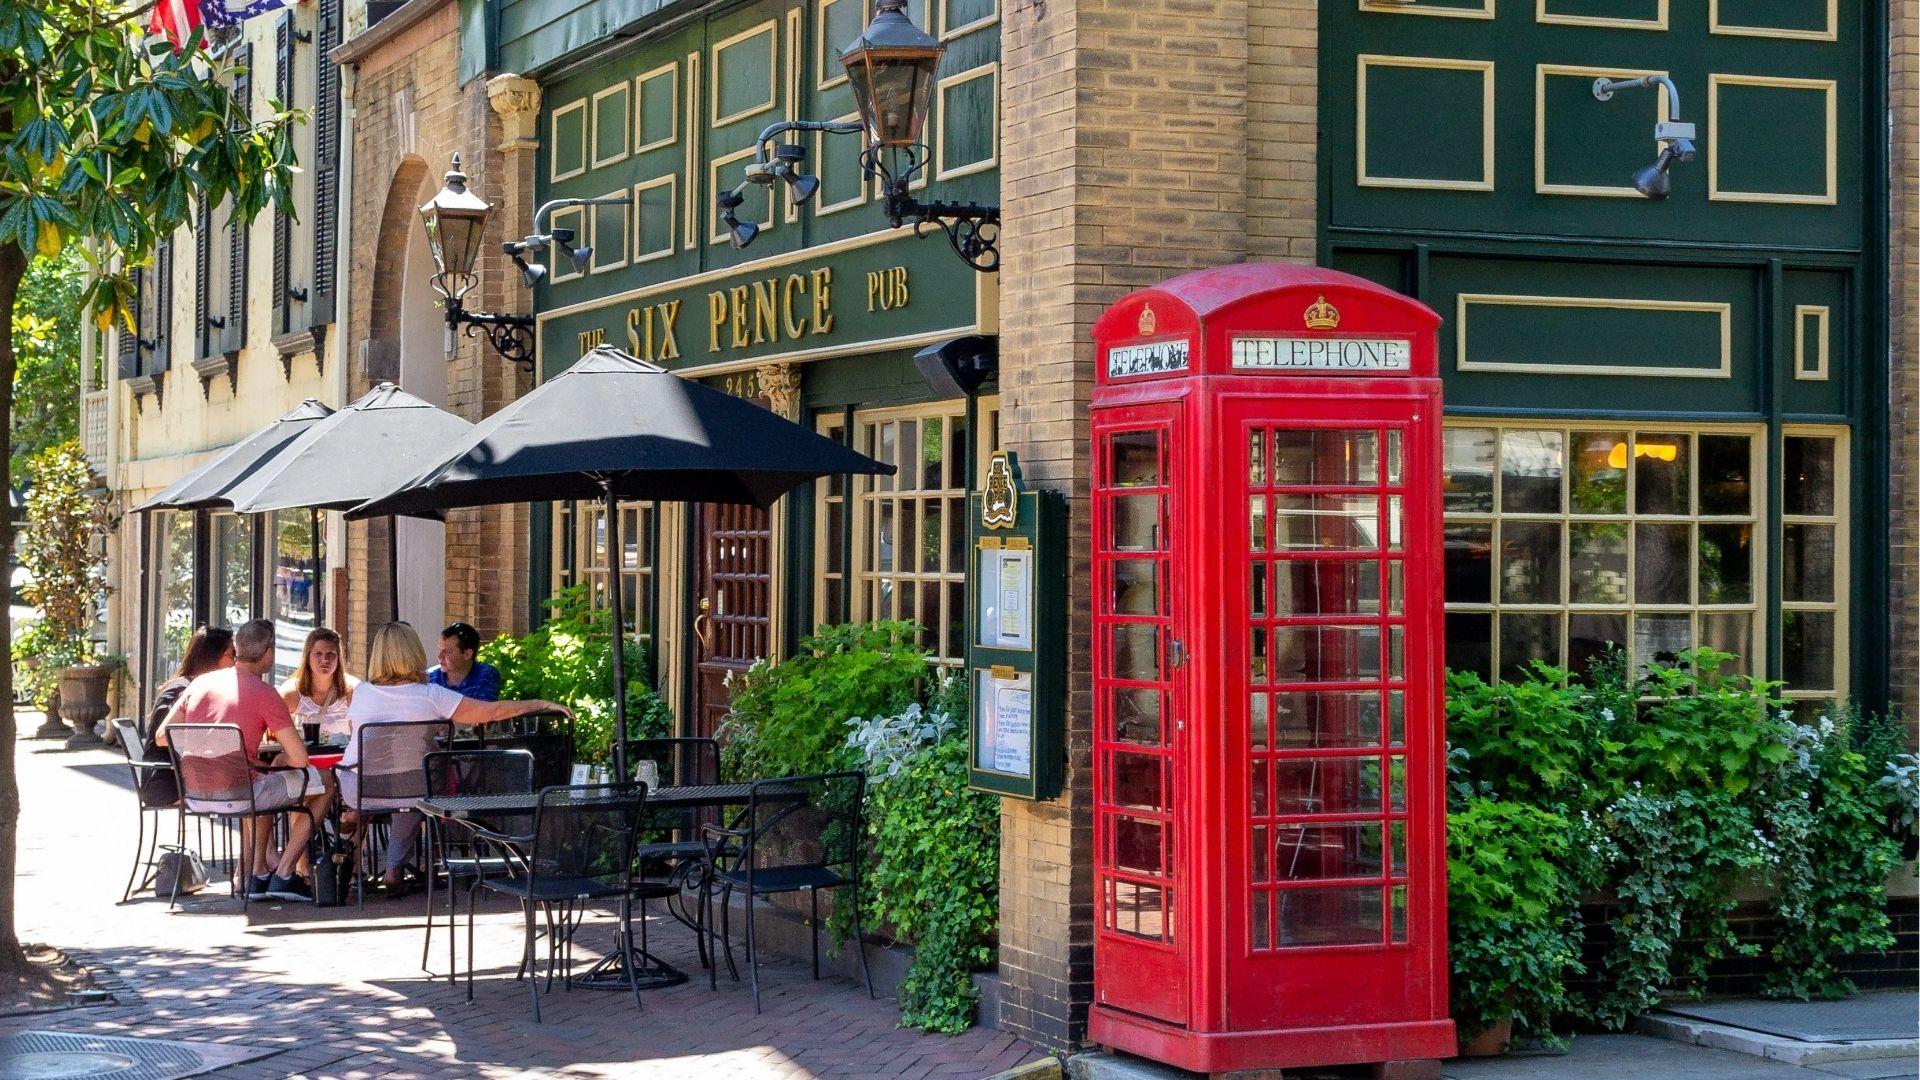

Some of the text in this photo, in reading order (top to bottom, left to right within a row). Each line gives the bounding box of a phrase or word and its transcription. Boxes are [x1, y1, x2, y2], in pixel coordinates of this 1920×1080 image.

[578, 265, 909, 362] THE SIX PENCE PUB
[1111, 342, 1188, 376] TELEPHONE
[1237, 340, 1400, 368] TELEPHONE
[726, 375, 754, 398] 245
